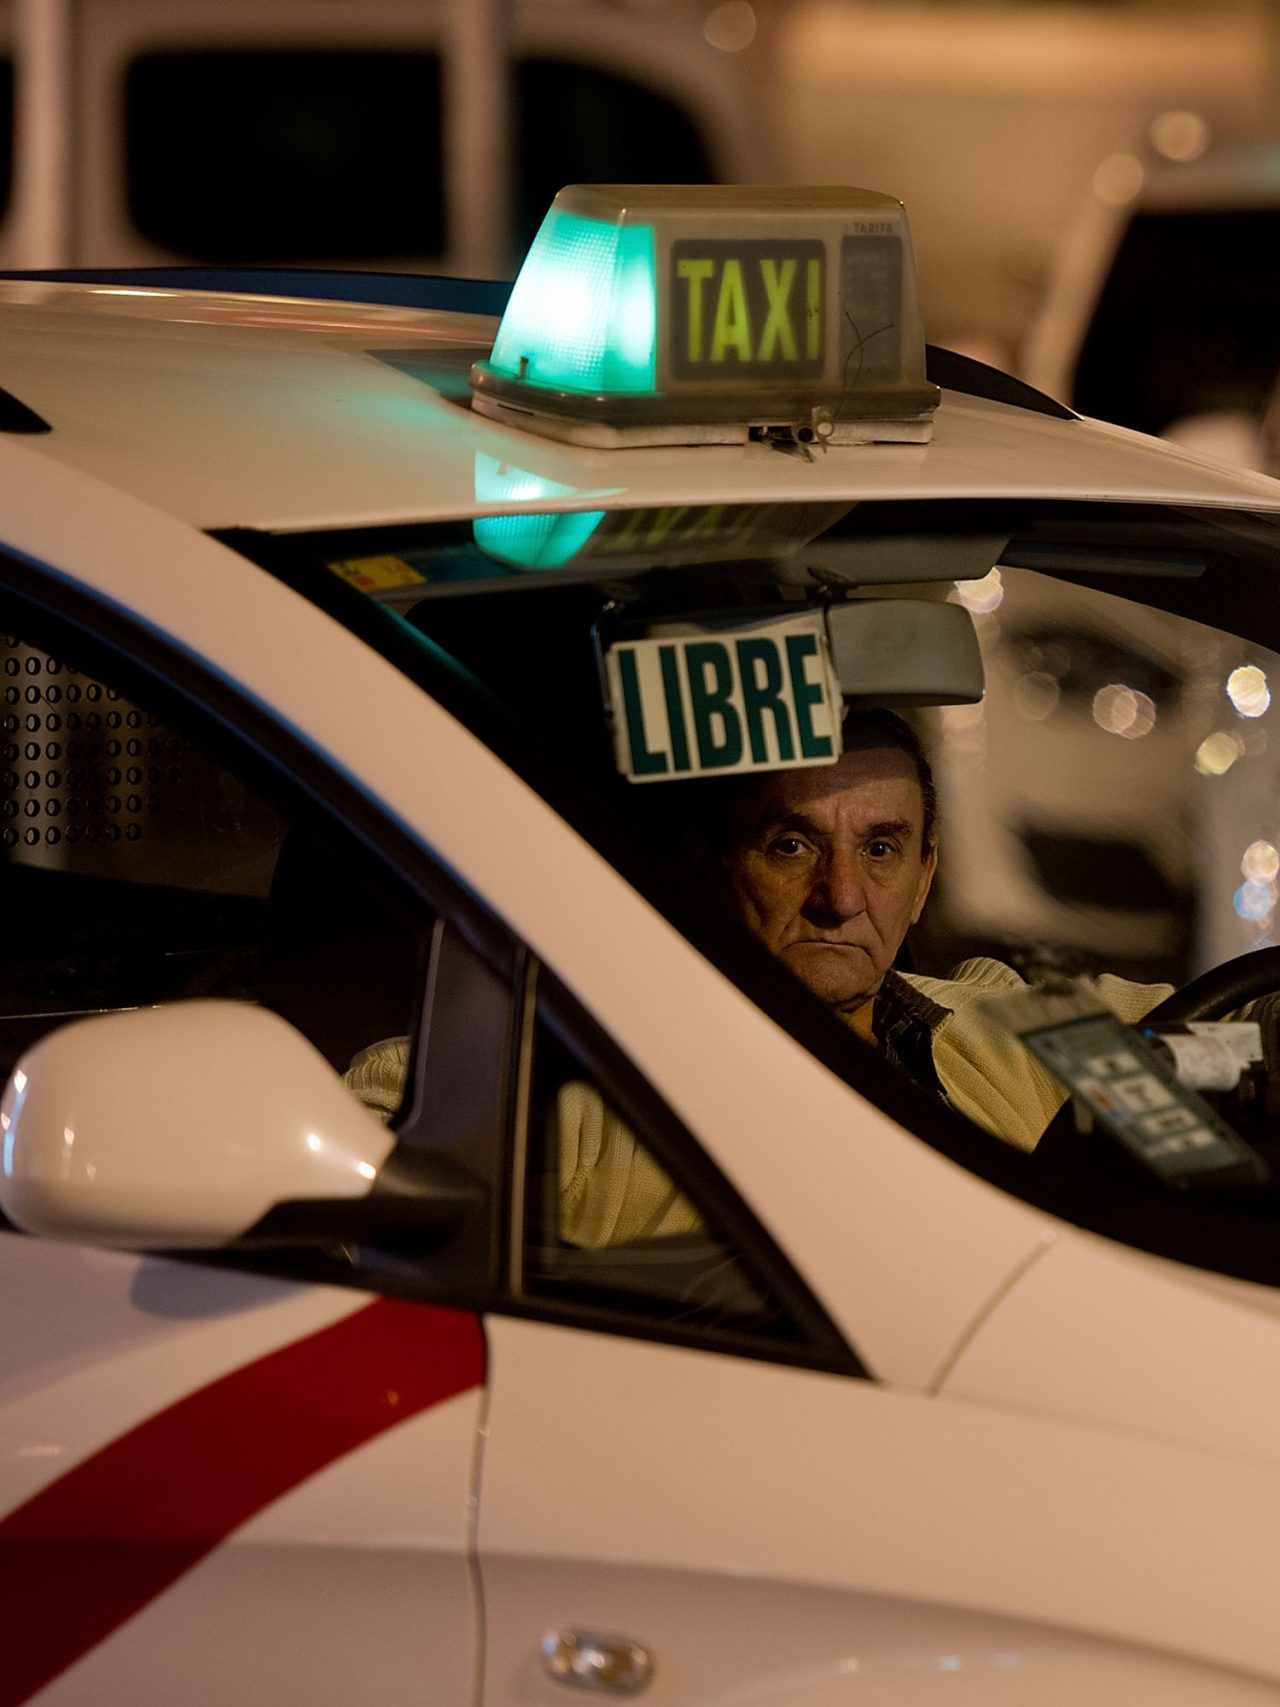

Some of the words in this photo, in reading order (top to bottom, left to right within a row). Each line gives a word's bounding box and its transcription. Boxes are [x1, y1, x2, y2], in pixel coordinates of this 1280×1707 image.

[854, 222, 893, 234] TARIFA
[677, 259, 820, 362] TAXI
[618, 635, 833, 775] LIBRE
